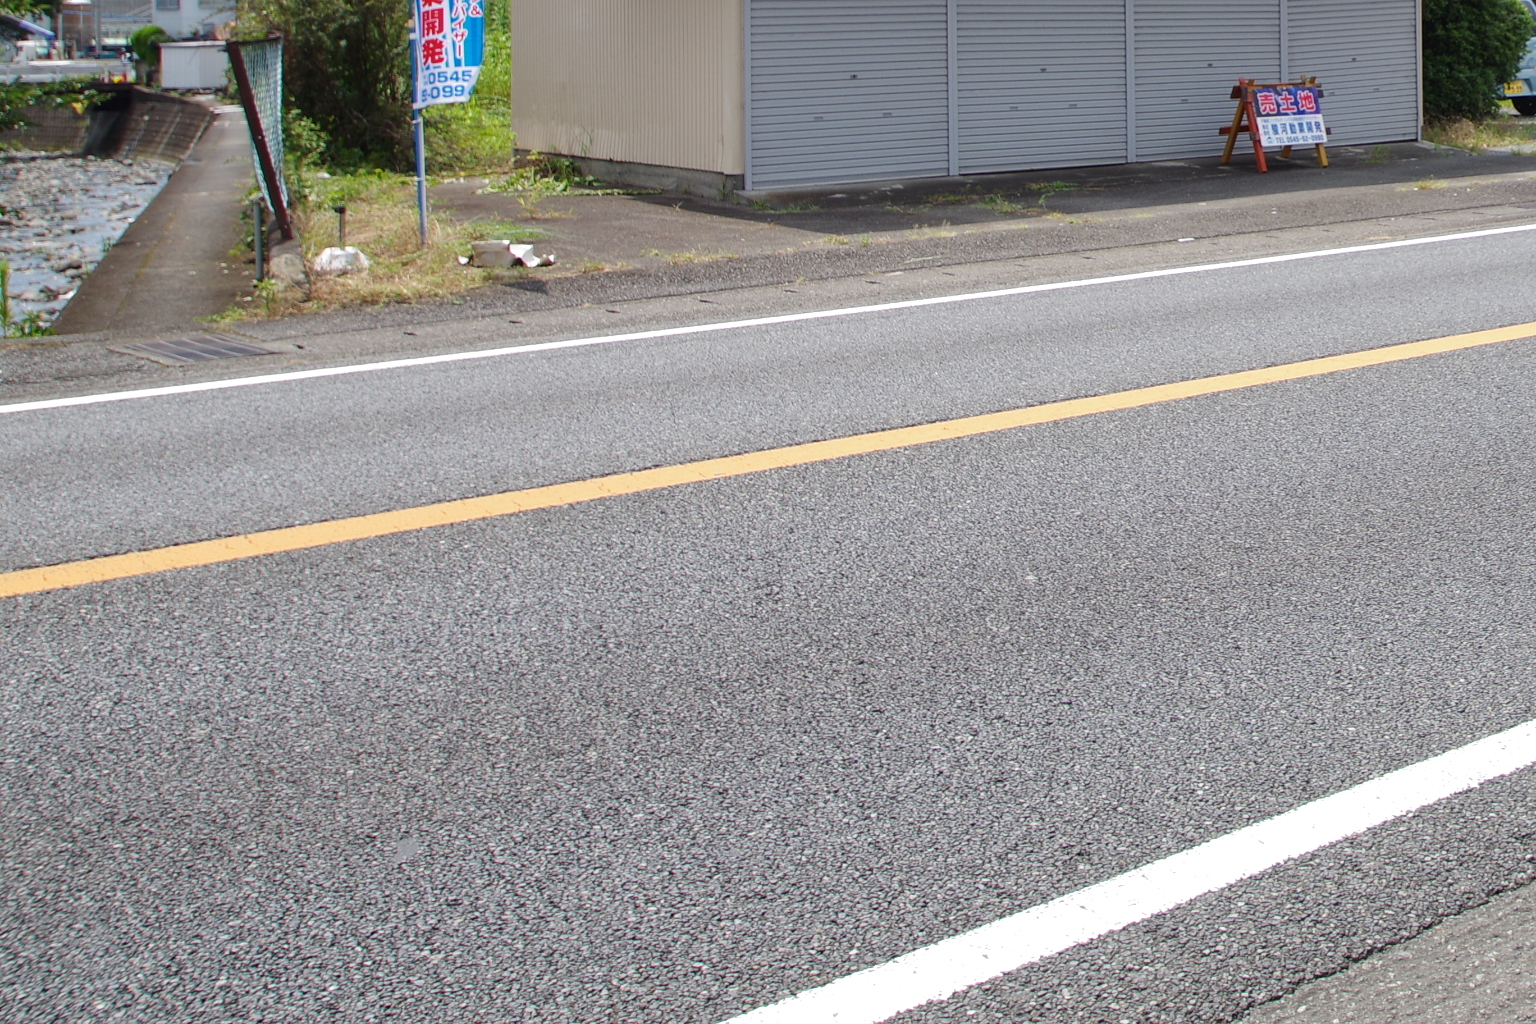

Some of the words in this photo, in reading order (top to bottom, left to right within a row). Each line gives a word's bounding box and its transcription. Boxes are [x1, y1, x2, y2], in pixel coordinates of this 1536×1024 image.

[428, 70, 472, 84] 0545
[1257, 91, 1316, 114] 売土地
